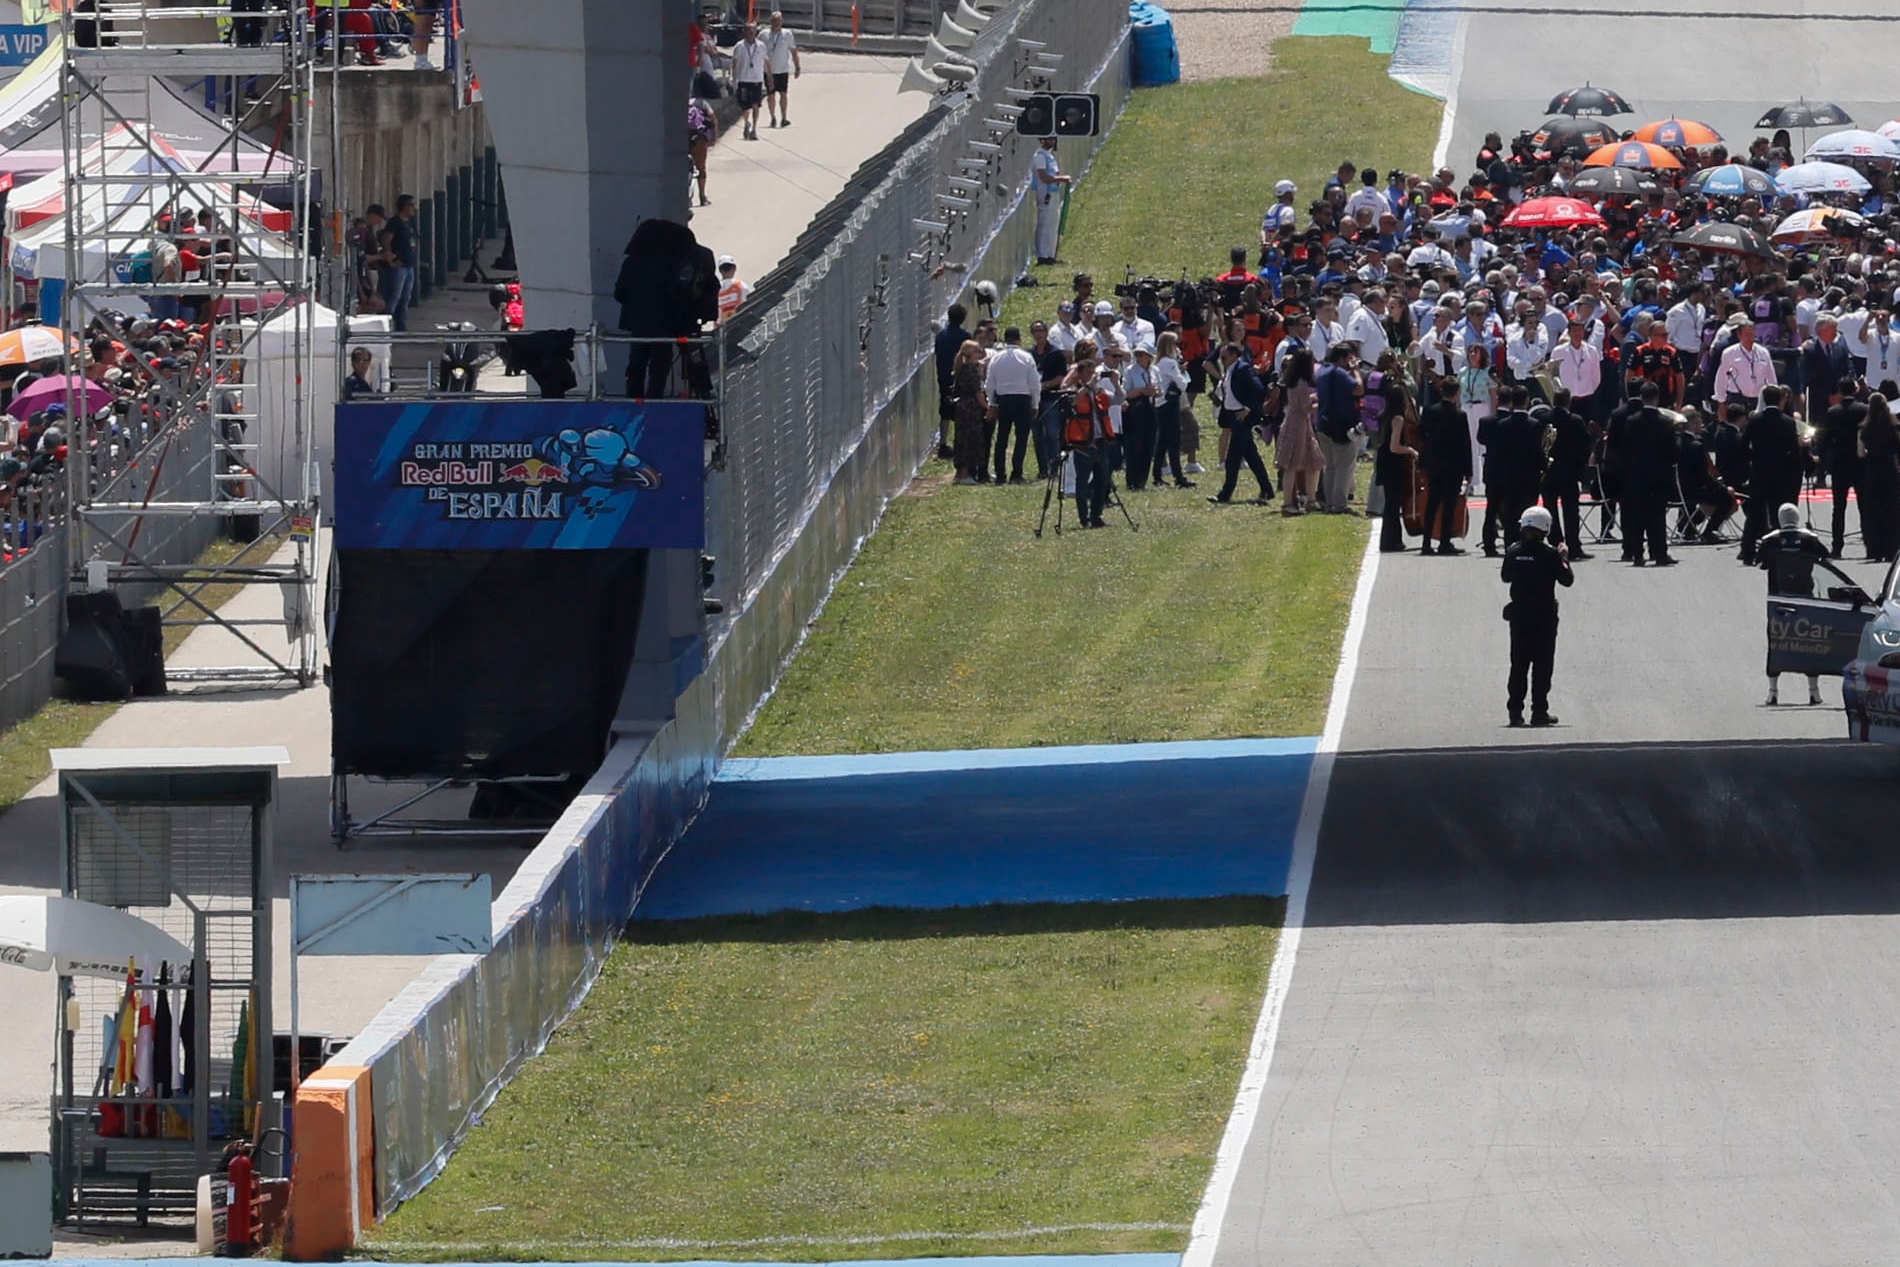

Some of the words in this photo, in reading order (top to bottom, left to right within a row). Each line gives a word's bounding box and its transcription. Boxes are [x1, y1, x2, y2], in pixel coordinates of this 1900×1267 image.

[13, 34, 43, 54] VIP
[1709, 234, 1737, 246] aprilia
[415, 444, 463, 459] GRAN
[470, 443, 533, 459] PREMIO
[401, 461, 449, 485] Red
[449, 461, 493, 484] Bull
[428, 487, 448, 500] DE
[448, 487, 564, 519] ESPAÑA
[1793, 618, 1833, 639] Car
